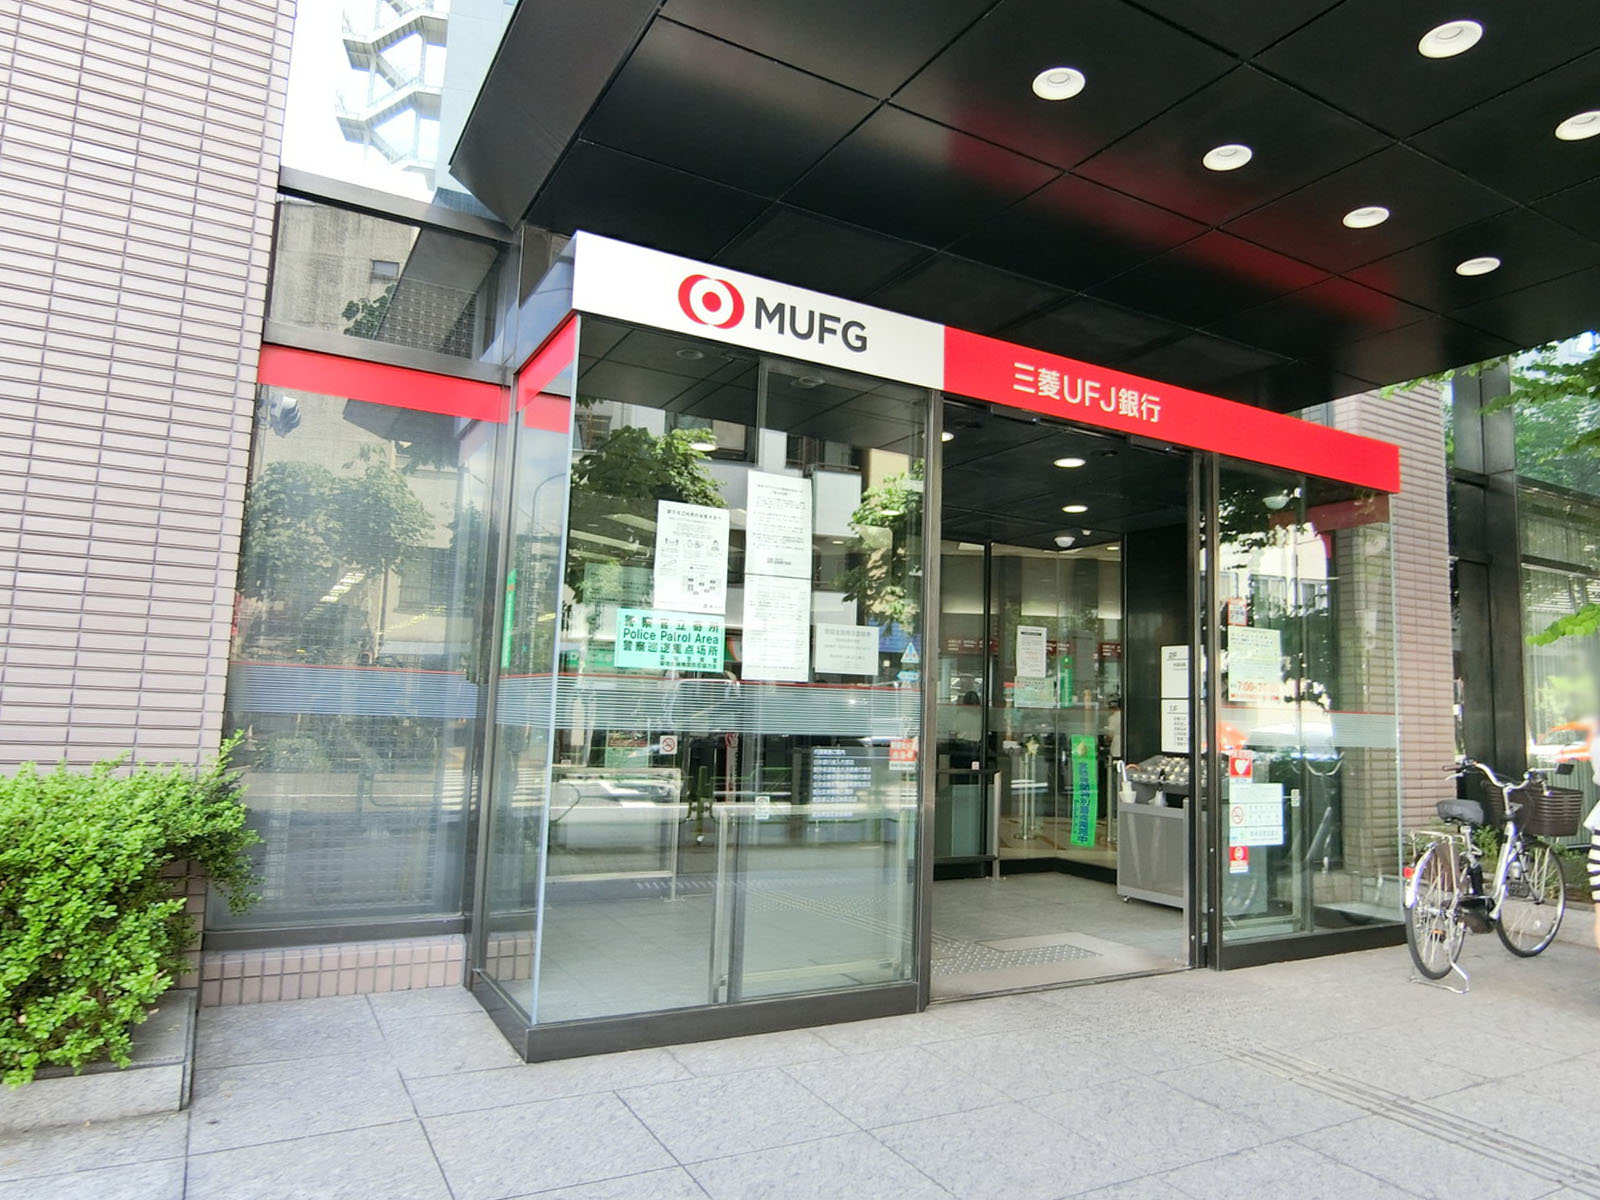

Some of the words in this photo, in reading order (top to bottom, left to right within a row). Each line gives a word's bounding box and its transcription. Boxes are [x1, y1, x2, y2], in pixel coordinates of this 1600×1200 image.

[755, 297, 868, 353] MUFG
[1013, 362, 1162, 423] 三菱UFJ銀行
[623, 628, 656, 641] Police
[660, 630, 691, 643] Patrol
[694, 633, 719, 645] Area
